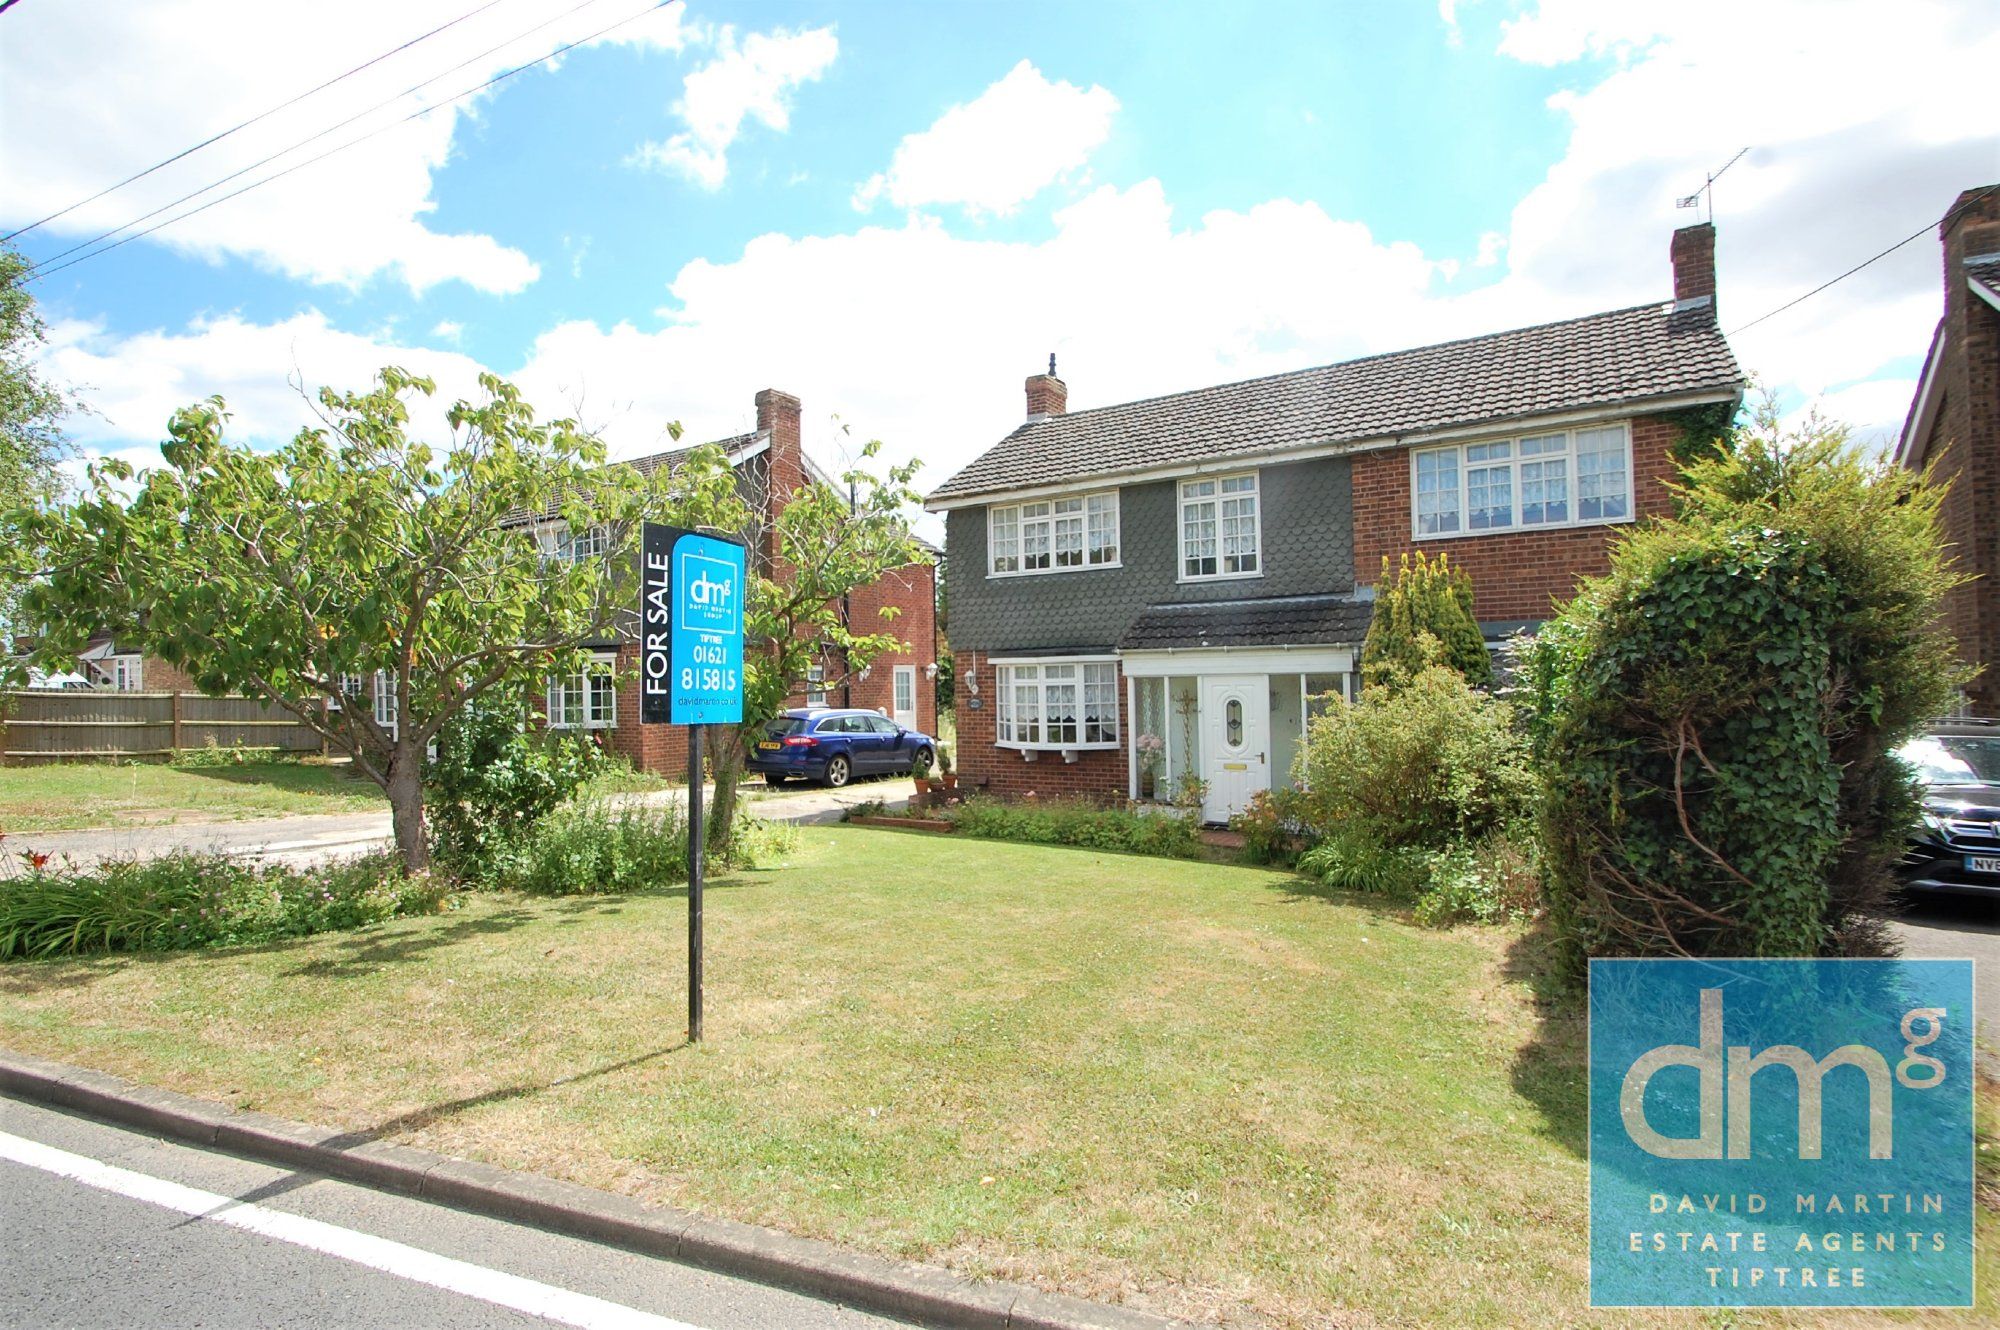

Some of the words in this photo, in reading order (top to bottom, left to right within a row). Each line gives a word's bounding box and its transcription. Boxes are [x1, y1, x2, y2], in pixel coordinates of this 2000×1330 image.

[647, 552, 668, 625] SALE
[690, 570, 732, 606] dmg
[647, 632, 667, 694] FOR
[693, 645, 727, 665] 01621
[681, 667, 736, 691] 815815
